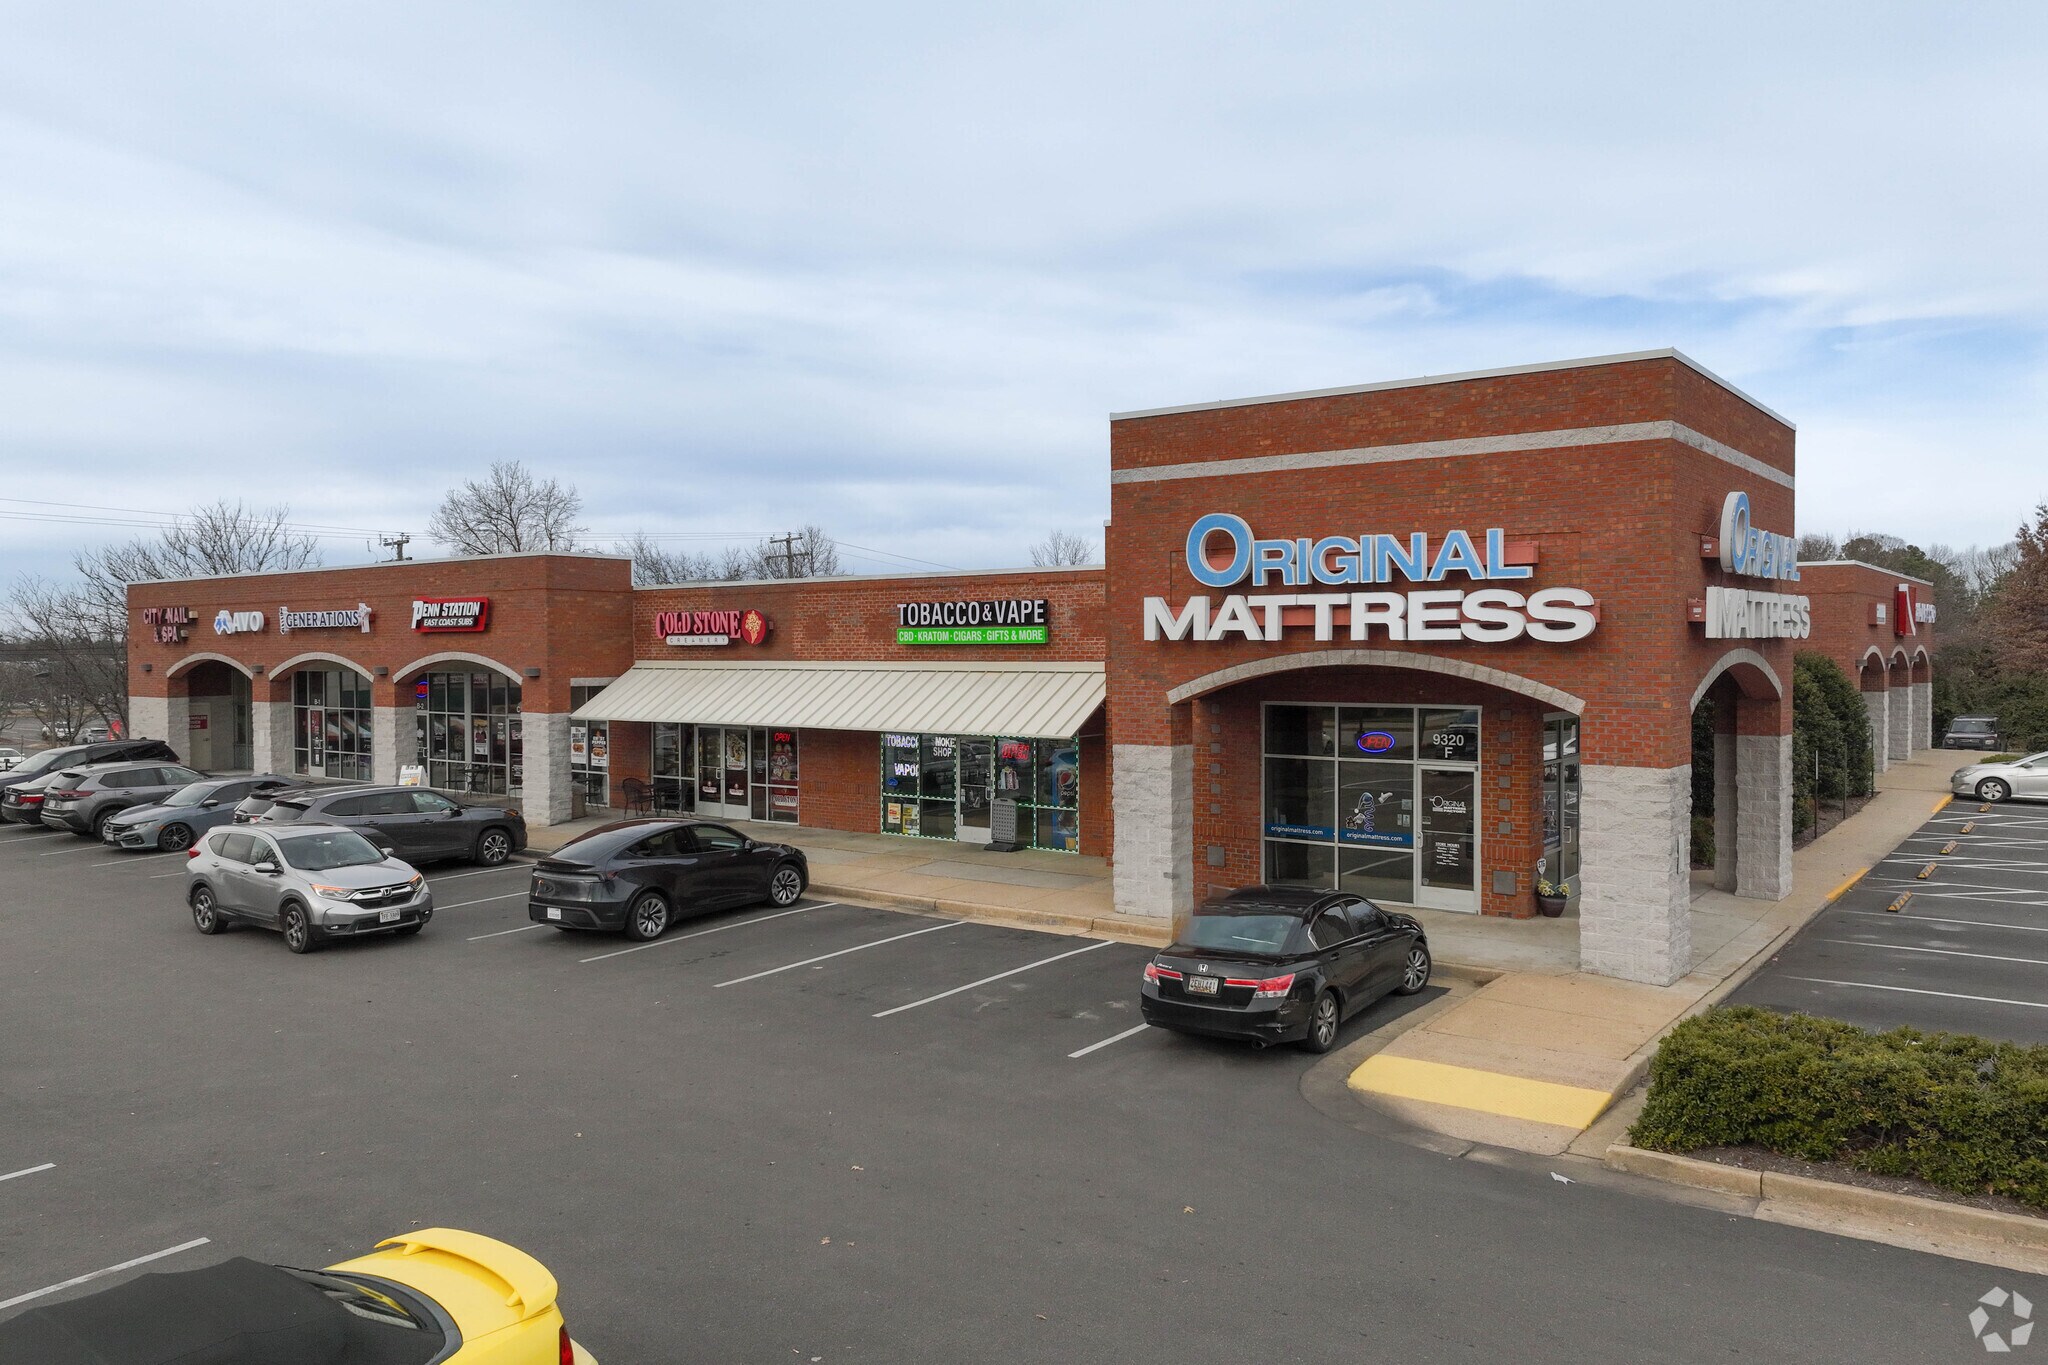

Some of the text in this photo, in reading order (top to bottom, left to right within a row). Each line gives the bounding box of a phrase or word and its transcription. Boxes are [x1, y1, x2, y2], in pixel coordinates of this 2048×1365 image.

[1186, 513, 1533, 587] ORIGINAL
[143, 607, 188, 624] CITY NAIL
[285, 611, 359, 628] GENERATIONS
[411, 600, 481, 629] PENN STATION
[897, 600, 1044, 625] TOBACCO & VAPE
[1143, 587, 1598, 643] MATTRESS
[1706, 586, 1810, 639] MATTRESS
[424, 617, 473, 627] EAST COAST SUBS
[655, 610, 741, 639] COLD STONE
[162, 626, 178, 642] SPA
[898, 629, 1043, 641] CBD KRATOM CIGARS GIFTS & MORE
[774, 732, 791, 743] OPEN
[1360, 735, 1391, 749] OPEN
[1432, 733, 1464, 747] 9320
[933, 747, 952, 757] SHOP
[1444, 747, 1453, 758] F
[1271, 826, 1324, 836] originalmattress.com
[1346, 832, 1402, 842] originalmattress.com
